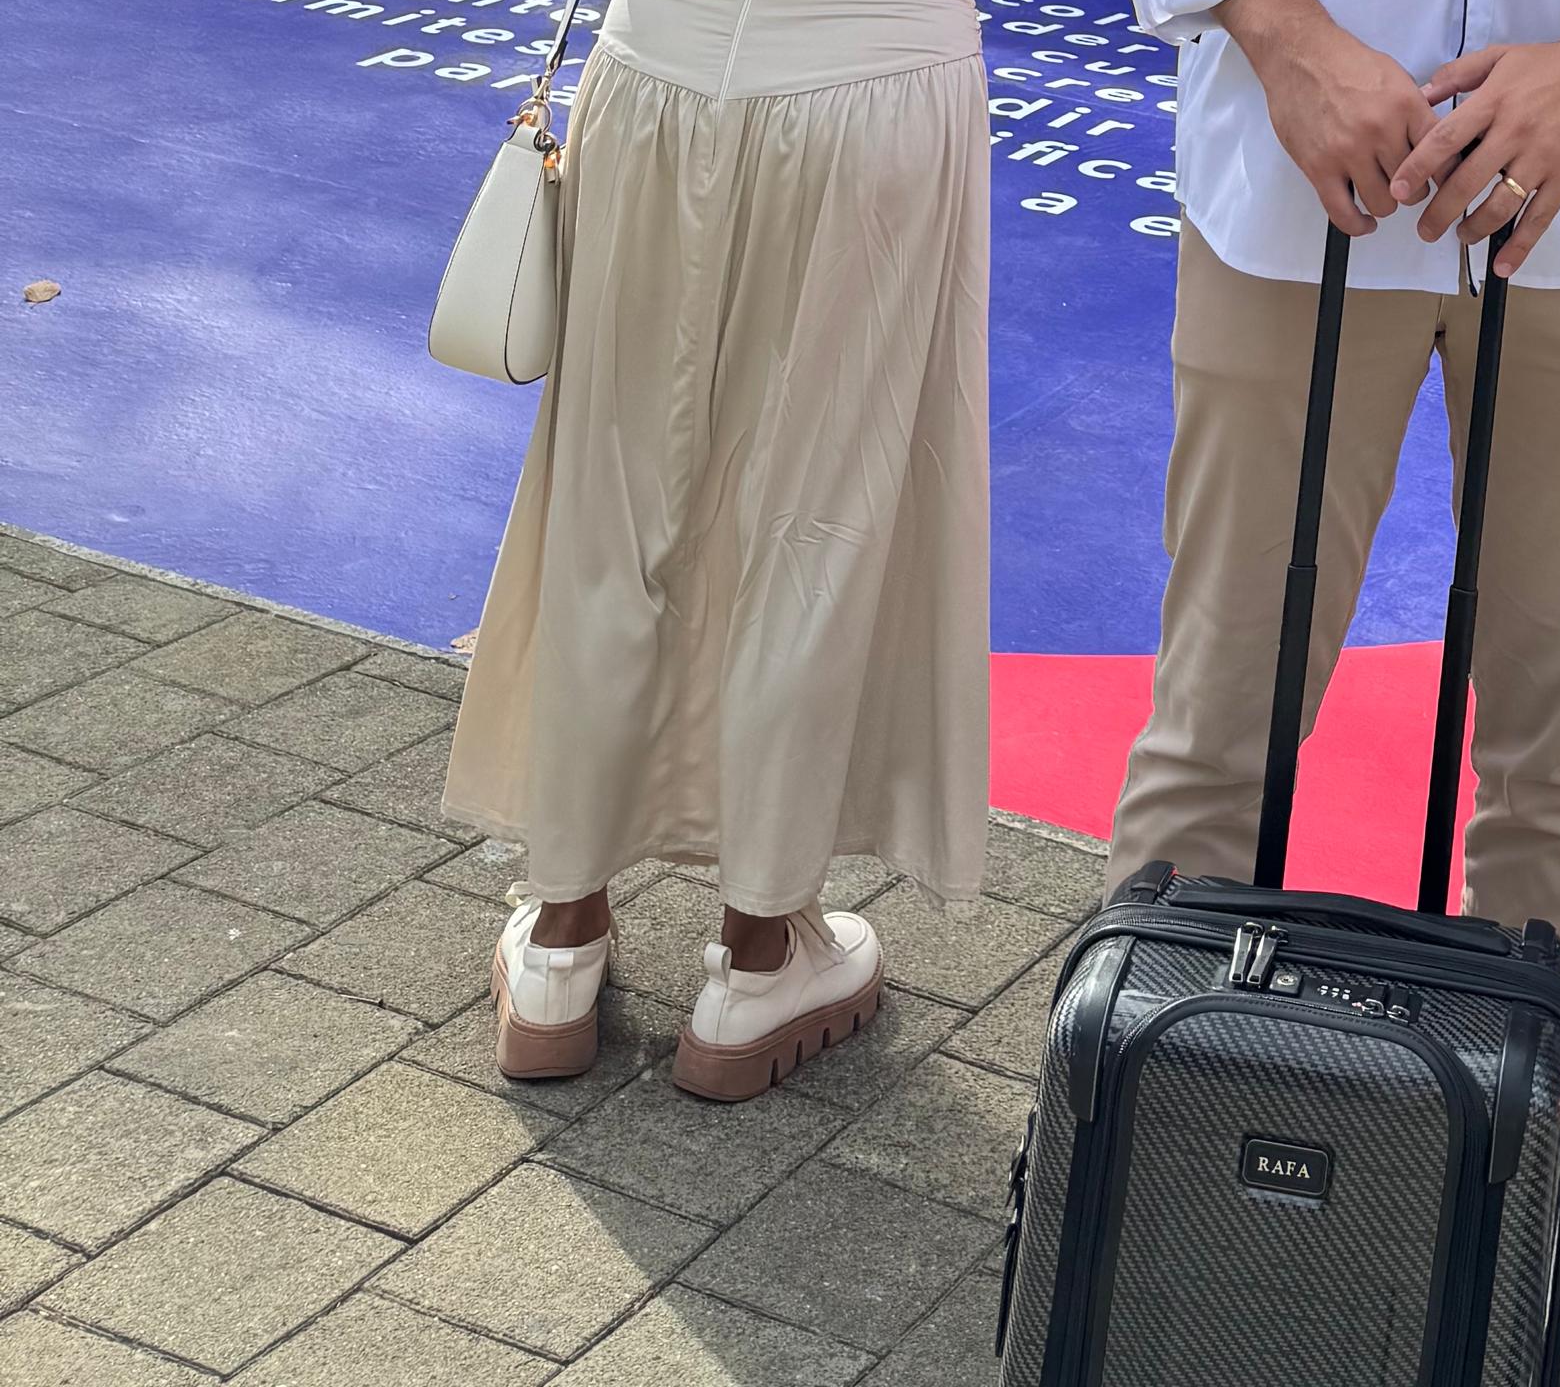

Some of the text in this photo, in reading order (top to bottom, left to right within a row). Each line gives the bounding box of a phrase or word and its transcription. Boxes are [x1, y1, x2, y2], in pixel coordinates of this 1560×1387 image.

[356, 47, 577, 107] para
[1020, 192, 1078, 215] a
[1257, 1156, 1310, 1179] RAFA
